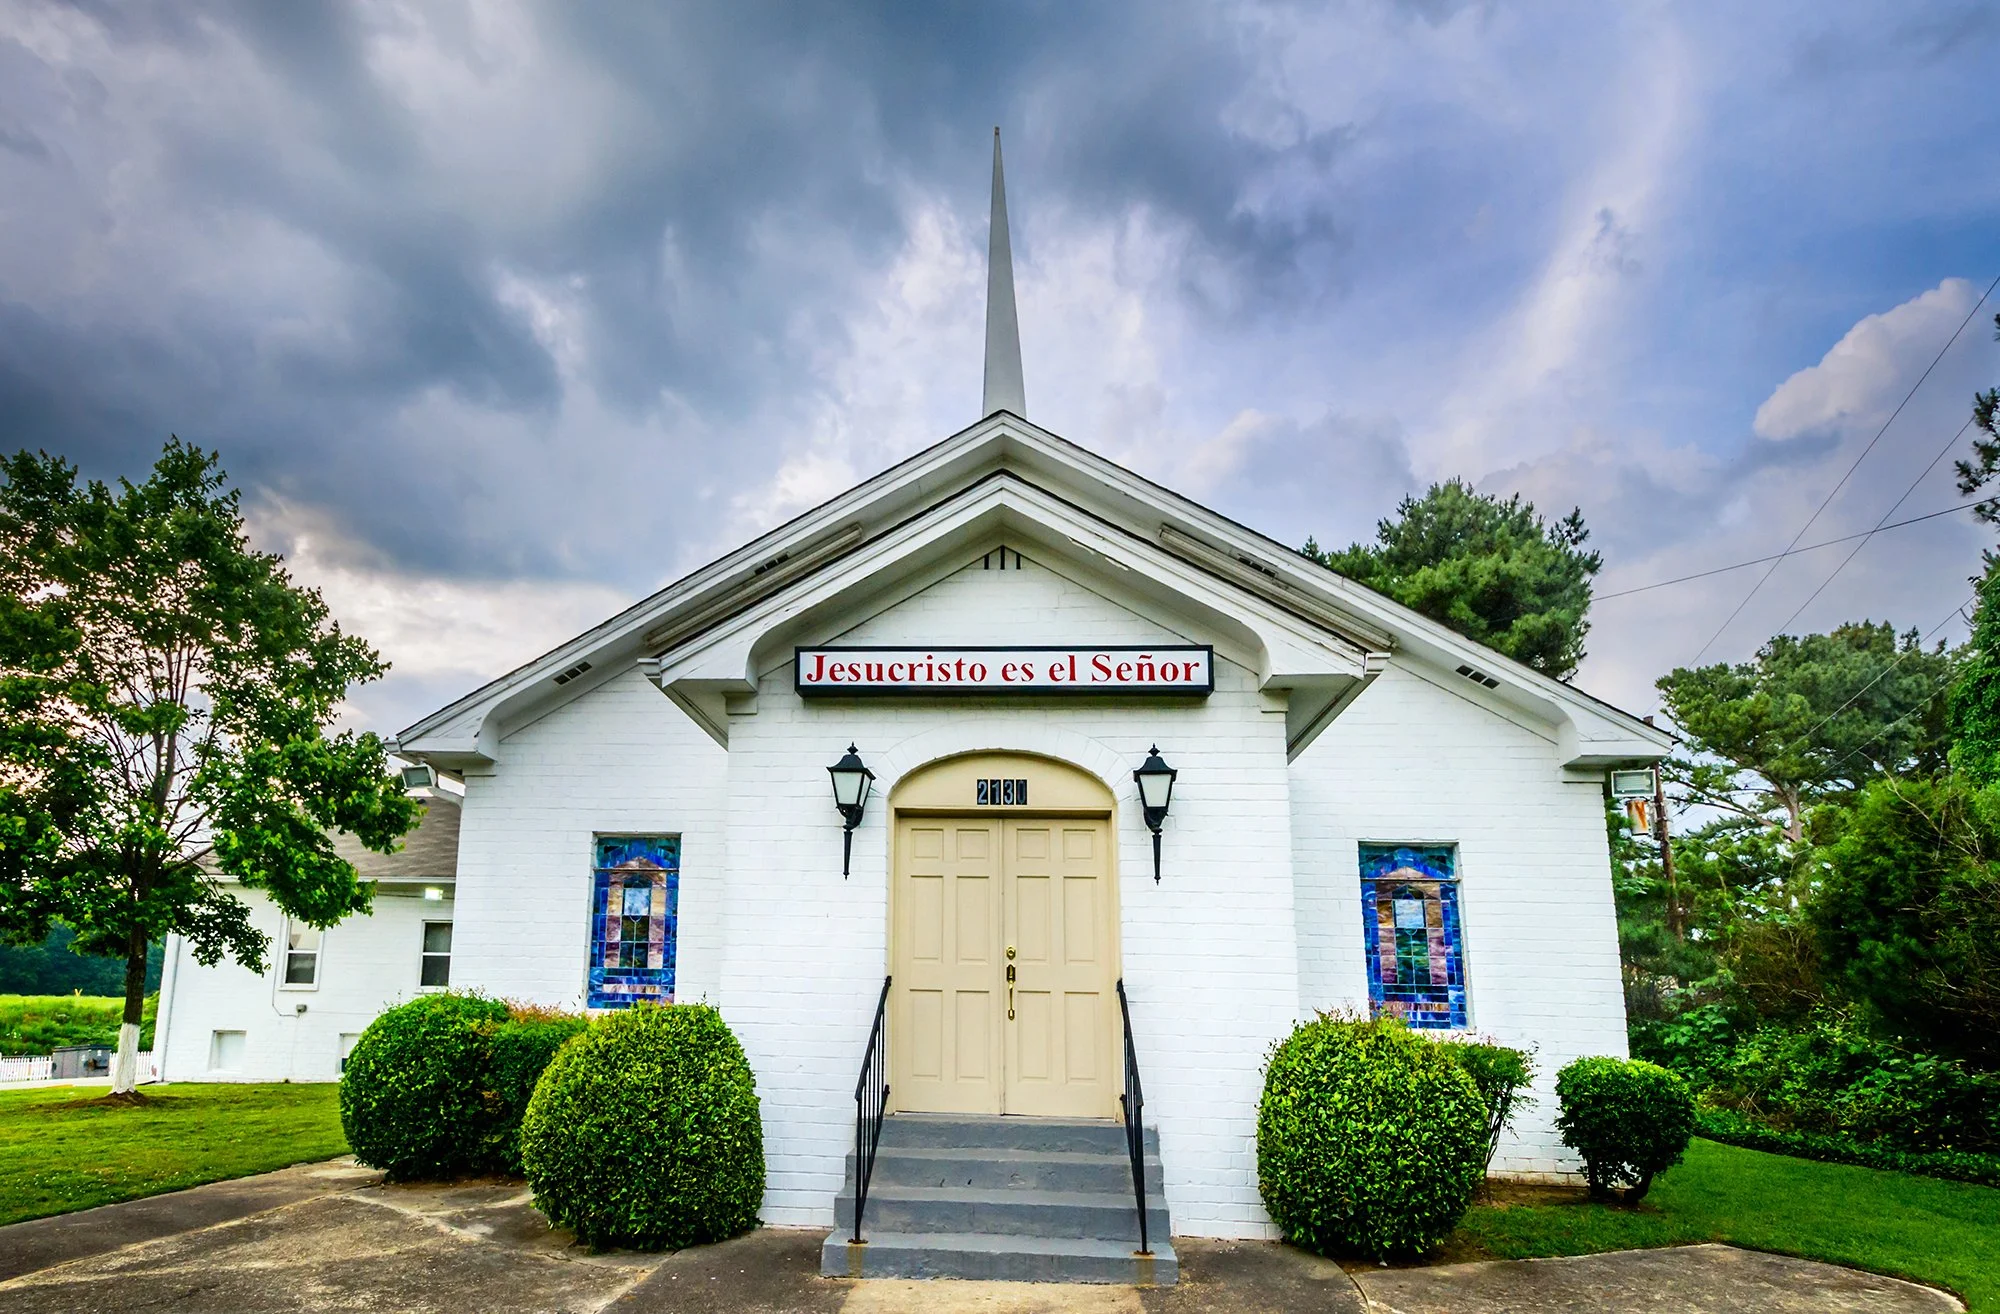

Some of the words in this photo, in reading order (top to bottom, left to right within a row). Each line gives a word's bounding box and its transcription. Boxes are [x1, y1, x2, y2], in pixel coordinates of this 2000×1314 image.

[806, 654, 987, 682] Jesucristo
[1001, 663, 1034, 682] es
[1048, 655, 1077, 682] el
[1091, 654, 1200, 682] Señor
[977, 780, 1026, 804] 2130
